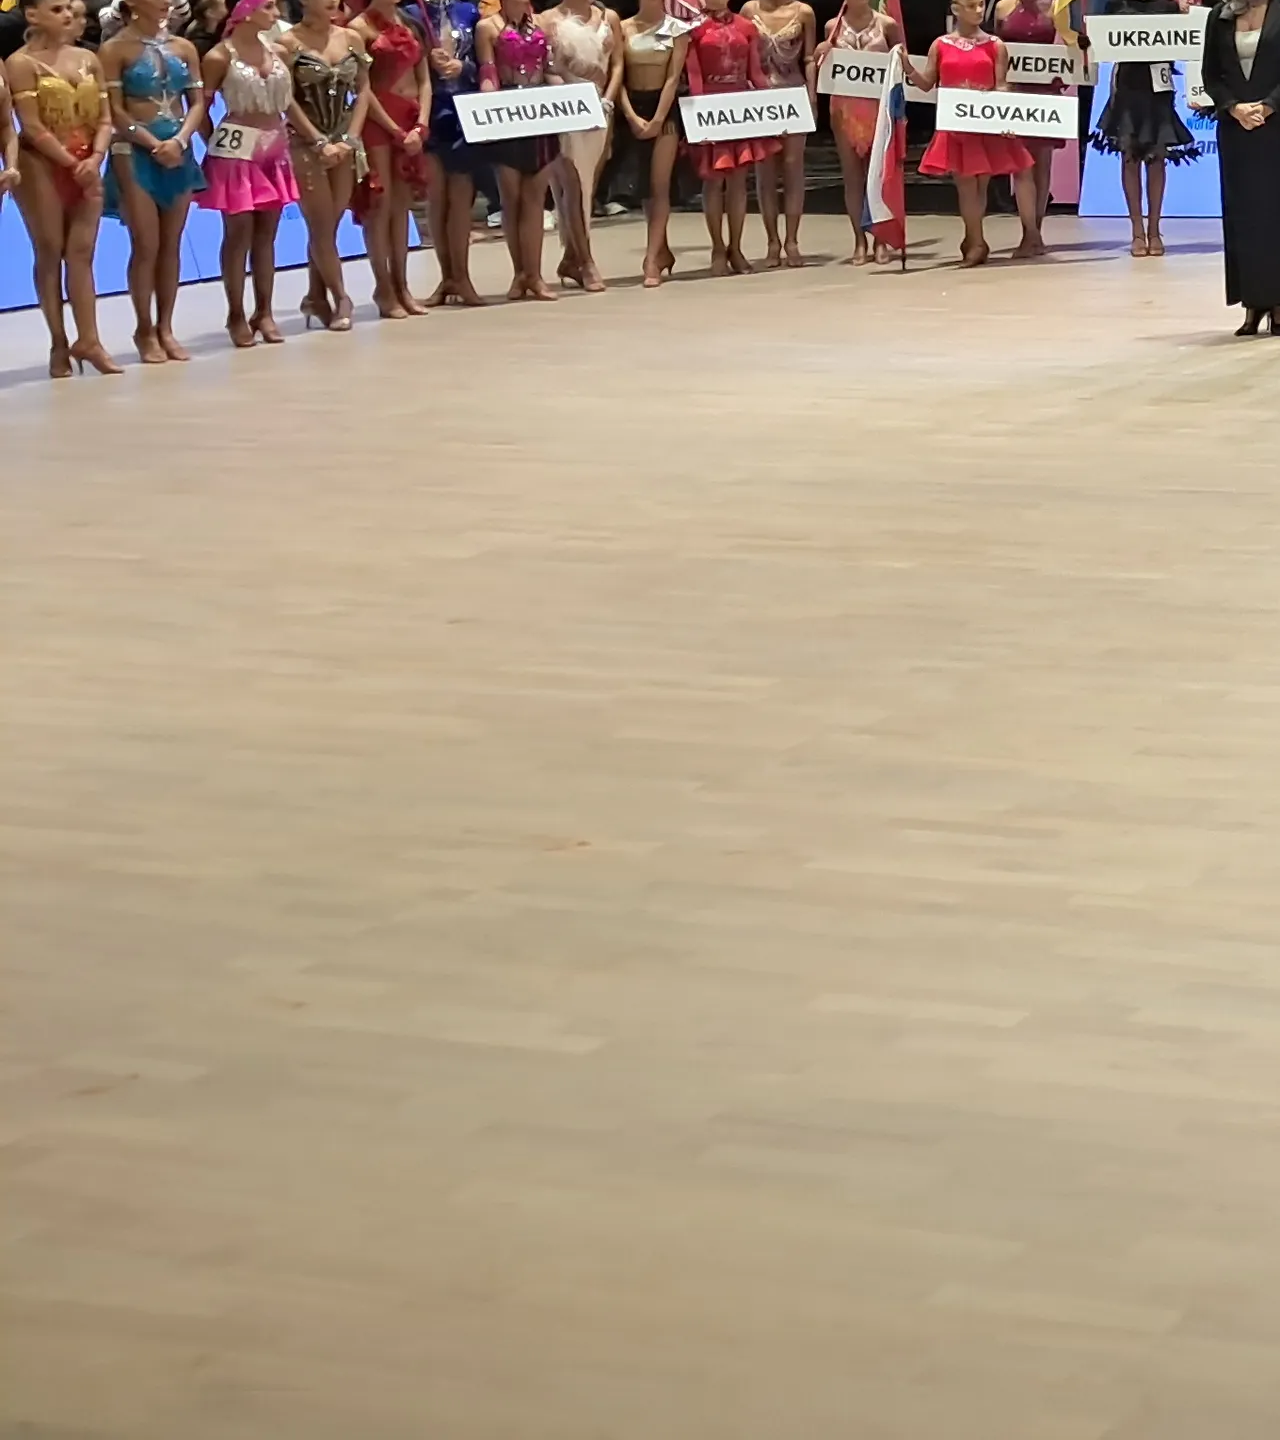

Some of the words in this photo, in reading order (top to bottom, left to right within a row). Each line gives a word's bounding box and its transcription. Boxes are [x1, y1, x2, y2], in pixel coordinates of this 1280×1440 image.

[1108, 29, 1201, 47] UKRAINE
[831, 63, 914, 86] PORT
[1007, 55, 1075, 74] WEDEN
[471, 99, 592, 126] LITHUANIA
[696, 103, 800, 127] MALAYSIA
[955, 102, 1062, 125] SLOVAKIA
[215, 127, 243, 150] 28
